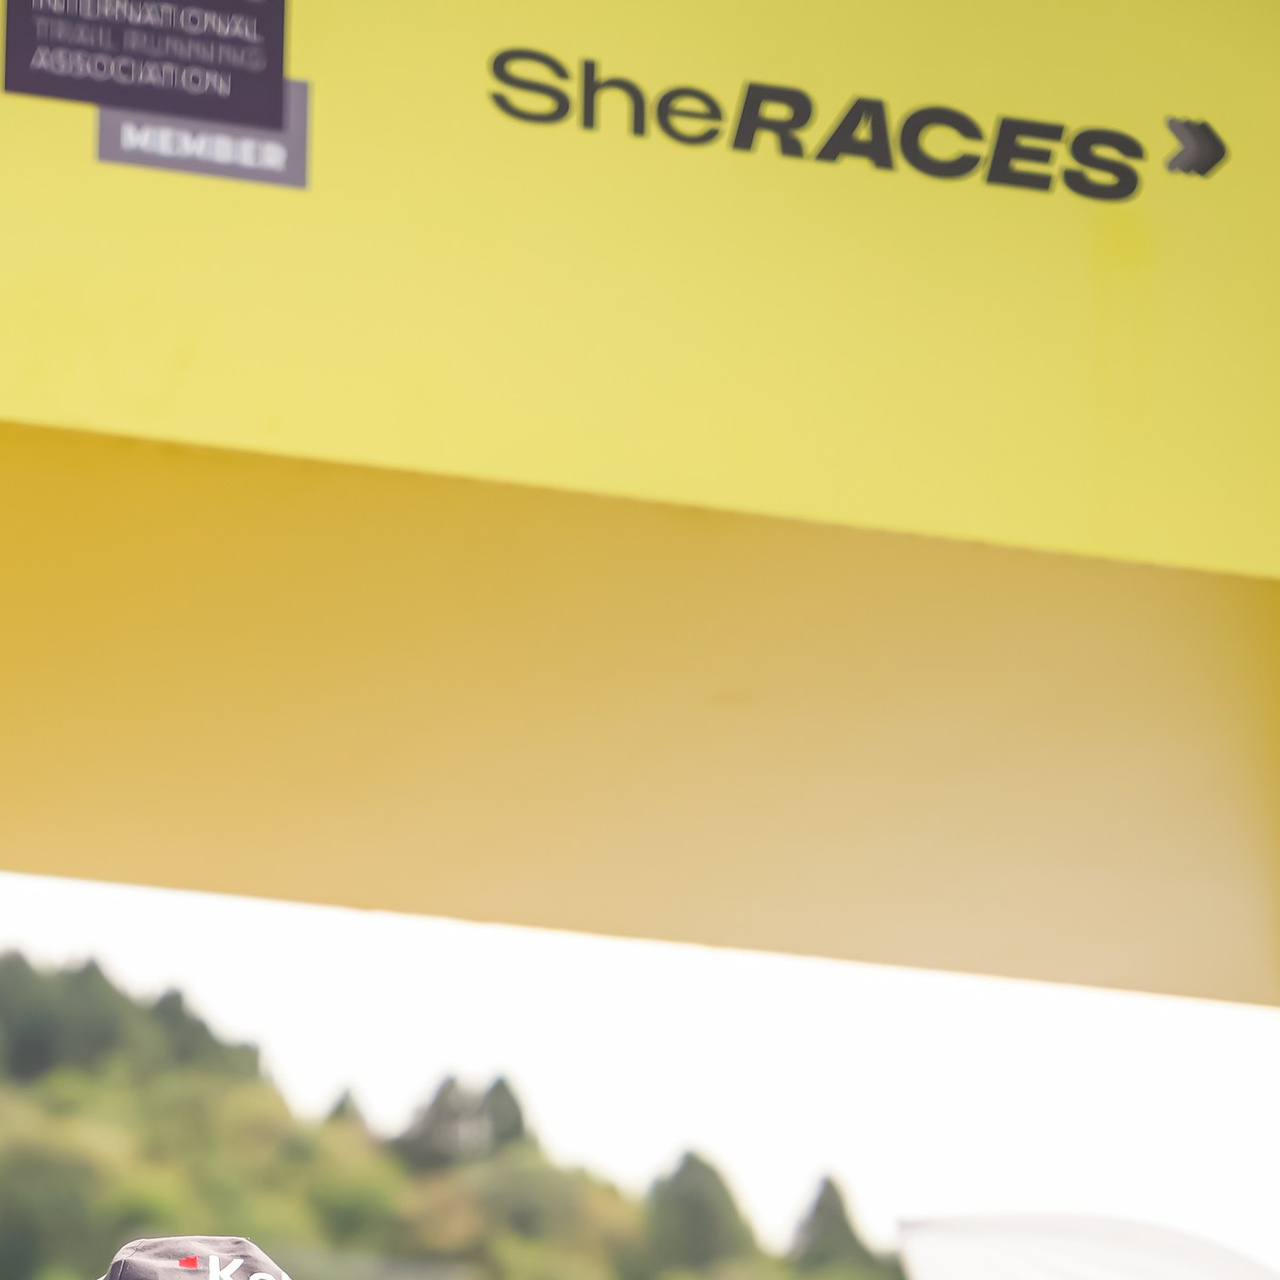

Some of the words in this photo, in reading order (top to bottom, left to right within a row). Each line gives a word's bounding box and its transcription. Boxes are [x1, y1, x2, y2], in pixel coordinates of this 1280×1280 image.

[30, 45, 231, 96] ASSOCIATION
[120, 121, 288, 172] MEMBER
[489, 47, 1147, 202] SheRACES
